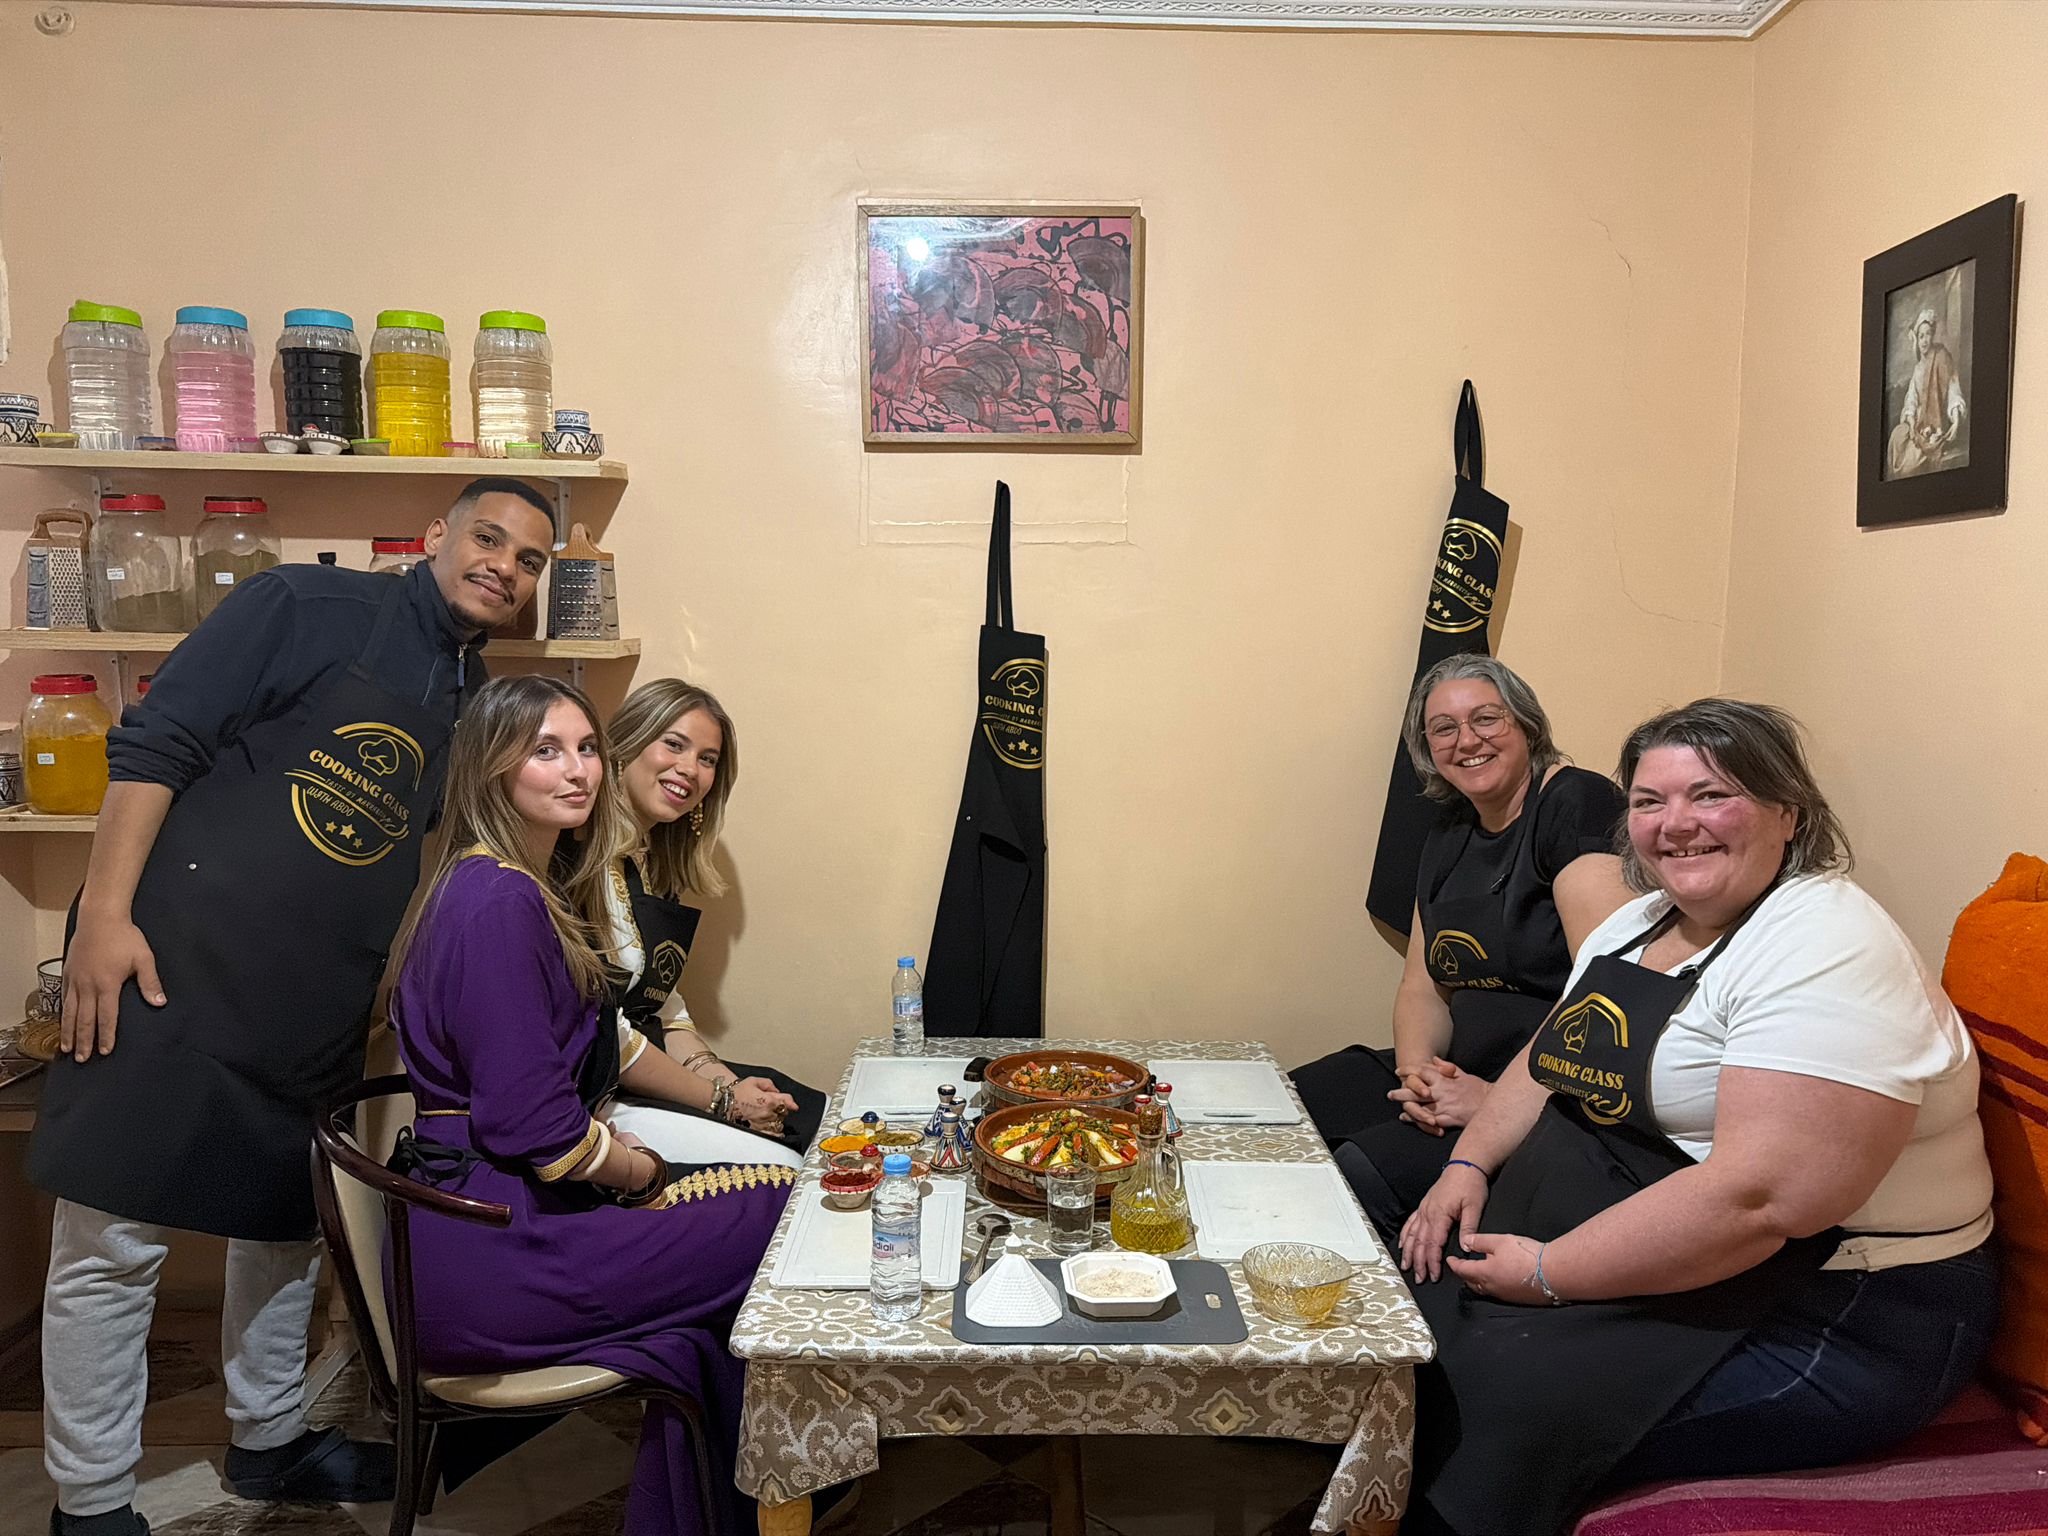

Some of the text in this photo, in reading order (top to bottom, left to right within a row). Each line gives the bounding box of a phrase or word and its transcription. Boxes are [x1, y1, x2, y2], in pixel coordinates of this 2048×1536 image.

[1436, 558, 1463, 578] KING
[1464, 574, 1494, 599] CLAS
[985, 695, 1035, 715] COOKING
[309, 749, 410, 821] COOKING CLASS
[330, 798, 355, 817] ABDO
[1537, 1052, 1625, 1090] COOKING CLASS
